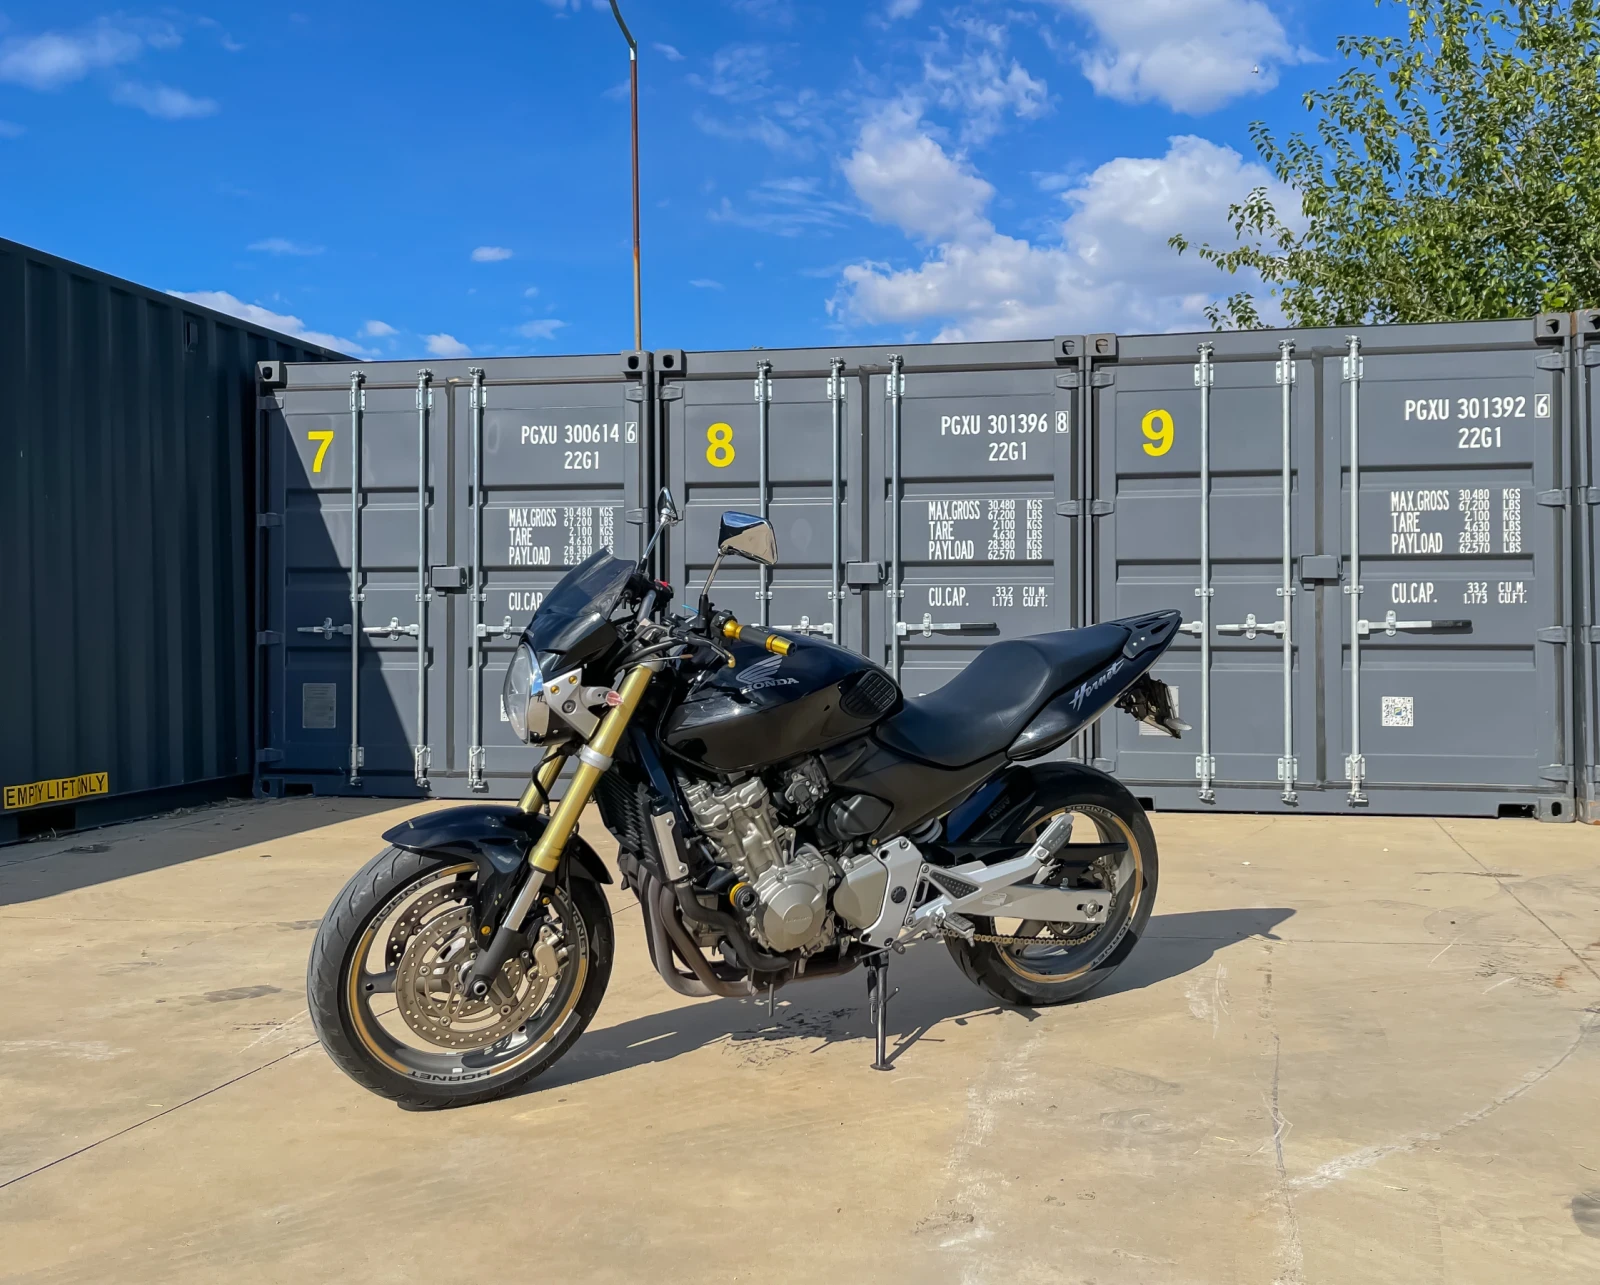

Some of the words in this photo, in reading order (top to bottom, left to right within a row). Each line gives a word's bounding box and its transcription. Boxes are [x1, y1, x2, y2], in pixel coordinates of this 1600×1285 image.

[1404, 398, 1450, 421] PGXU
[1457, 396, 1526, 420] 301392
[1536, 395, 1549, 417] 6
[941, 414, 981, 435] PGXU
[987, 413, 1048, 435] 301396
[1056, 411, 1068, 433] 8
[1141, 409, 1174, 457] 9
[521, 425, 558, 445] PGXU
[564, 423, 620, 444] 300614
[626, 422, 637, 443] 6
[1458, 426, 1502, 449] 22G1
[308, 431, 334, 473] 7
[706, 422, 736, 468] 8
[988, 441, 1027, 462] 22G1
[564, 451, 600, 470] 22G1
[1390, 490, 1450, 511] MAX.GROSS
[1458, 488, 1490, 501] 30.480
[1503, 488, 1521, 499] KGS
[1458, 500, 1490, 511] 67.200
[1503, 500, 1521, 510] LBS
[508, 507, 557, 527] MAX.GROSS
[563, 507, 593, 517] 30.480
[600, 507, 614, 516] KGS
[928, 500, 981, 521] MAX.GROSS
[987, 499, 1015, 510] 30.480
[1026, 499, 1043, 509] KGS
[987, 510, 1015, 520] 67.200
[1026, 510, 1043, 520] LBS
[563, 517, 593, 527] 67.200
[600, 517, 614, 526] LBS
[929, 520, 955, 540] TARE
[992, 520, 1015, 530] 2.100
[1026, 520, 1043, 530] KGS
[1391, 511, 1421, 533] TARE
[1464, 510, 1490, 522] 2.100
[1503, 510, 1521, 521] KGS
[1464, 521, 1490, 532] 4.630
[1503, 521, 1521, 532] LBS
[509, 527, 533, 546] TARE
[569, 527, 593, 536] 2.100
[600, 526, 614, 536] KGS
[568, 536, 593, 546] 4.630
[600, 536, 614, 545] LBS
[992, 529, 1015, 540] 4.630
[1026, 530, 1043, 540] LBS
[1391, 532, 1443, 554] PAYLOAD
[1458, 532, 1490, 543] 28.380
[1503, 532, 1521, 543] KGS
[508, 546, 551, 566] PAYLOAD
[563, 546, 593, 555] 28.380
[929, 540, 975, 560] PAYLOAD
[987, 540, 1015, 550] 28.380
[1026, 540, 1043, 550] KGS
[987, 550, 1015, 560] 62.570
[1026, 550, 1043, 560] LBS
[1459, 542, 1491, 554] 62.570
[1503, 543, 1521, 553] LBS
[928, 587, 969, 607] CU.CAP.
[995, 586, 1014, 597] 33.2
[1022, 586, 1048, 597] CU.M.
[992, 597, 1014, 607] 1.173
[1022, 597, 1048, 607] CU.FT.
[1391, 582, 1438, 604] CU.CAP.
[1467, 582, 1488, 594] 33.2
[1498, 581, 1527, 593] CU.M.
[1463, 593, 1488, 604] 1.173
[1498, 593, 1528, 604] CU.FT.
[739, 677, 800, 695] HONDA
[1068, 657, 1125, 712] Hornet
[47, 780, 76, 800] LIFT
[407, 1069, 491, 1082] HORNET
